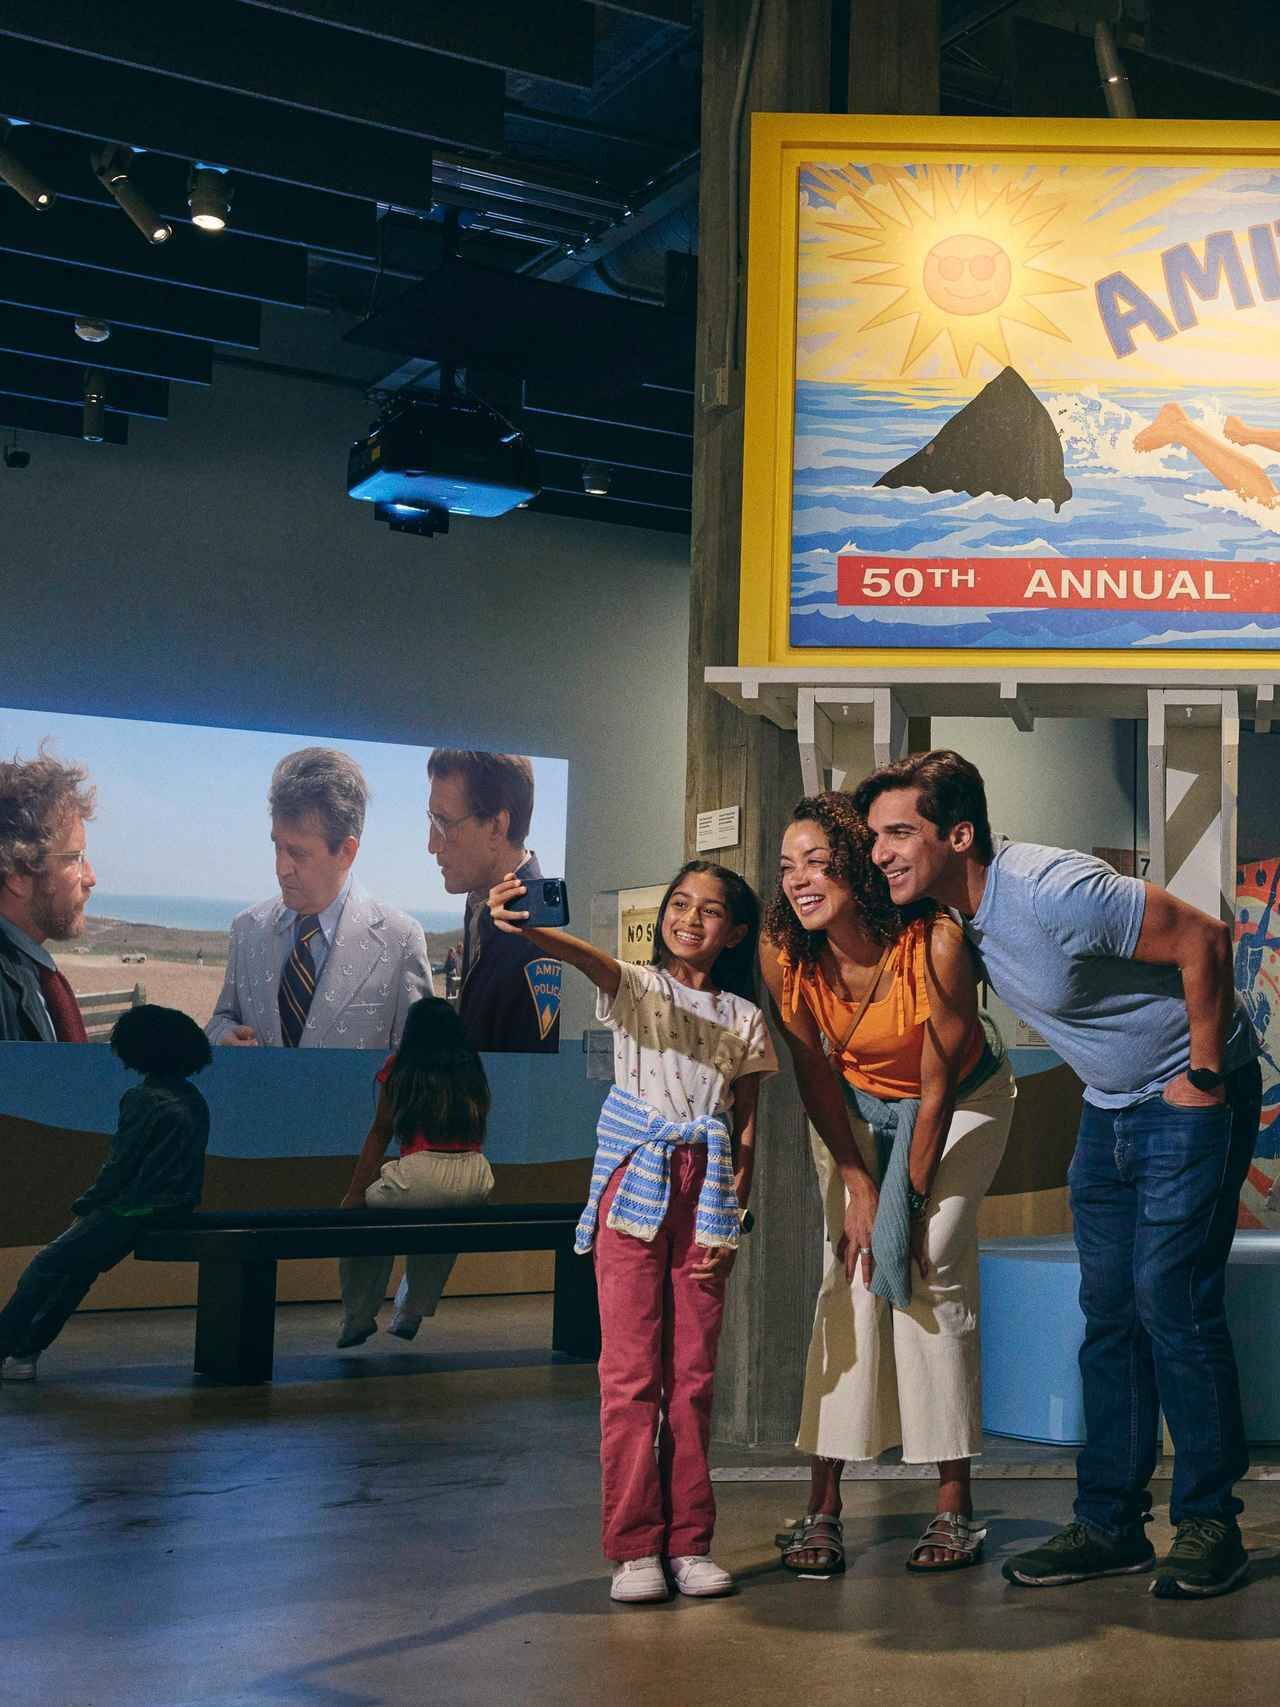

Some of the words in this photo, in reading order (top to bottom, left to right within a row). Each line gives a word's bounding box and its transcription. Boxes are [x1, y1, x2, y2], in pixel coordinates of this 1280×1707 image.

[861, 567, 976, 598] 50TH
[1023, 569, 1231, 600] ANNUAL
[627, 924, 643, 943] NO
